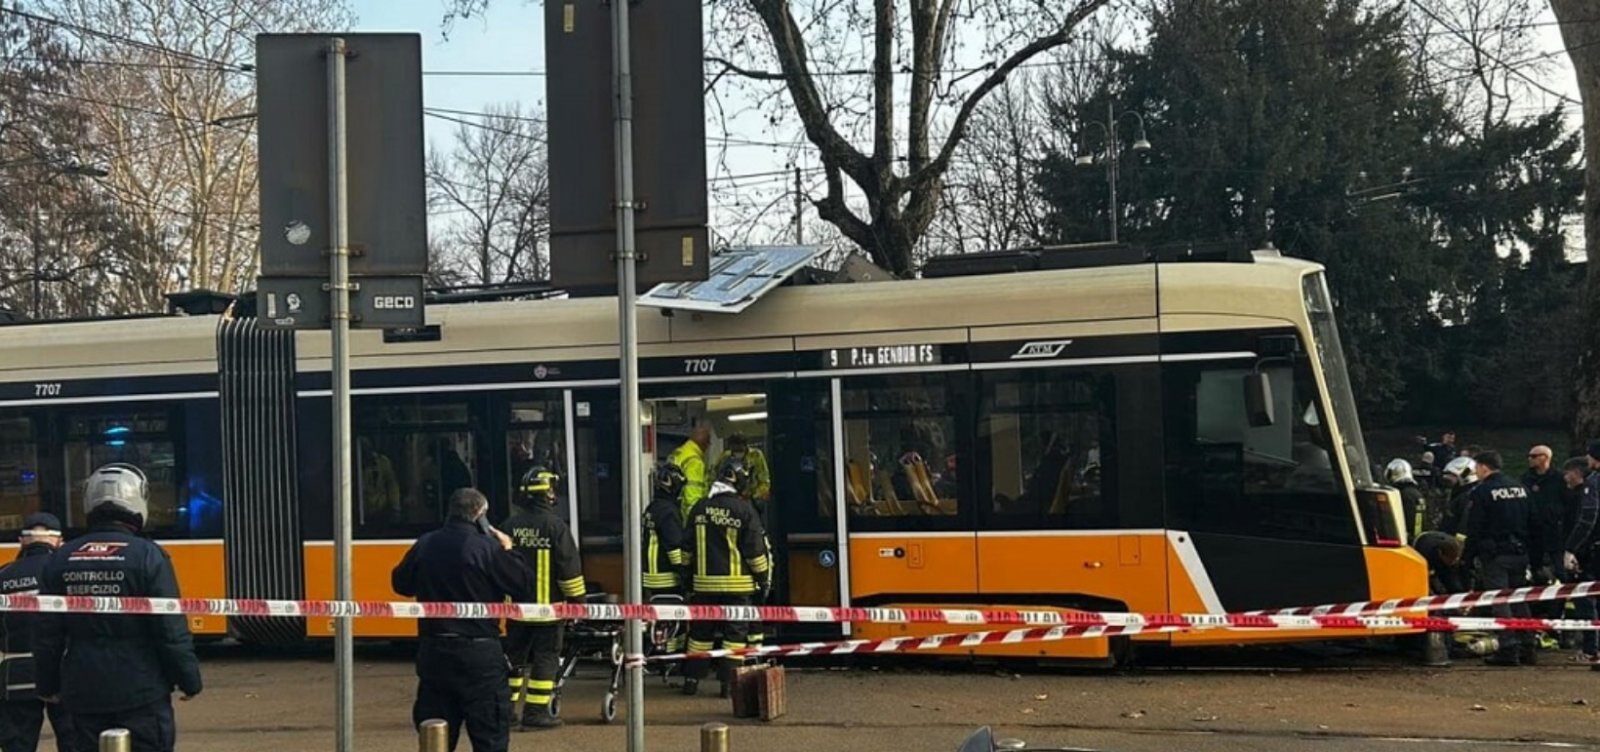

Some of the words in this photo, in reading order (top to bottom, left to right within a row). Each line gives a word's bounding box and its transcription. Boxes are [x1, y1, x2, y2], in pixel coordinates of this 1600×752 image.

[831, 349, 838, 366] 9
[851, 348, 874, 366] P.ta
[920, 345, 933, 362] FS
[684, 359, 717, 373] 7707
[35, 383, 61, 396] 7707
[1491, 487, 1527, 501] POLIZIA
[705, 506, 730, 517] VIGILI
[513, 527, 540, 538] VIGILI
[63, 570, 125, 582] CONTROLLO
[3, 576, 38, 590] POLIZIA
